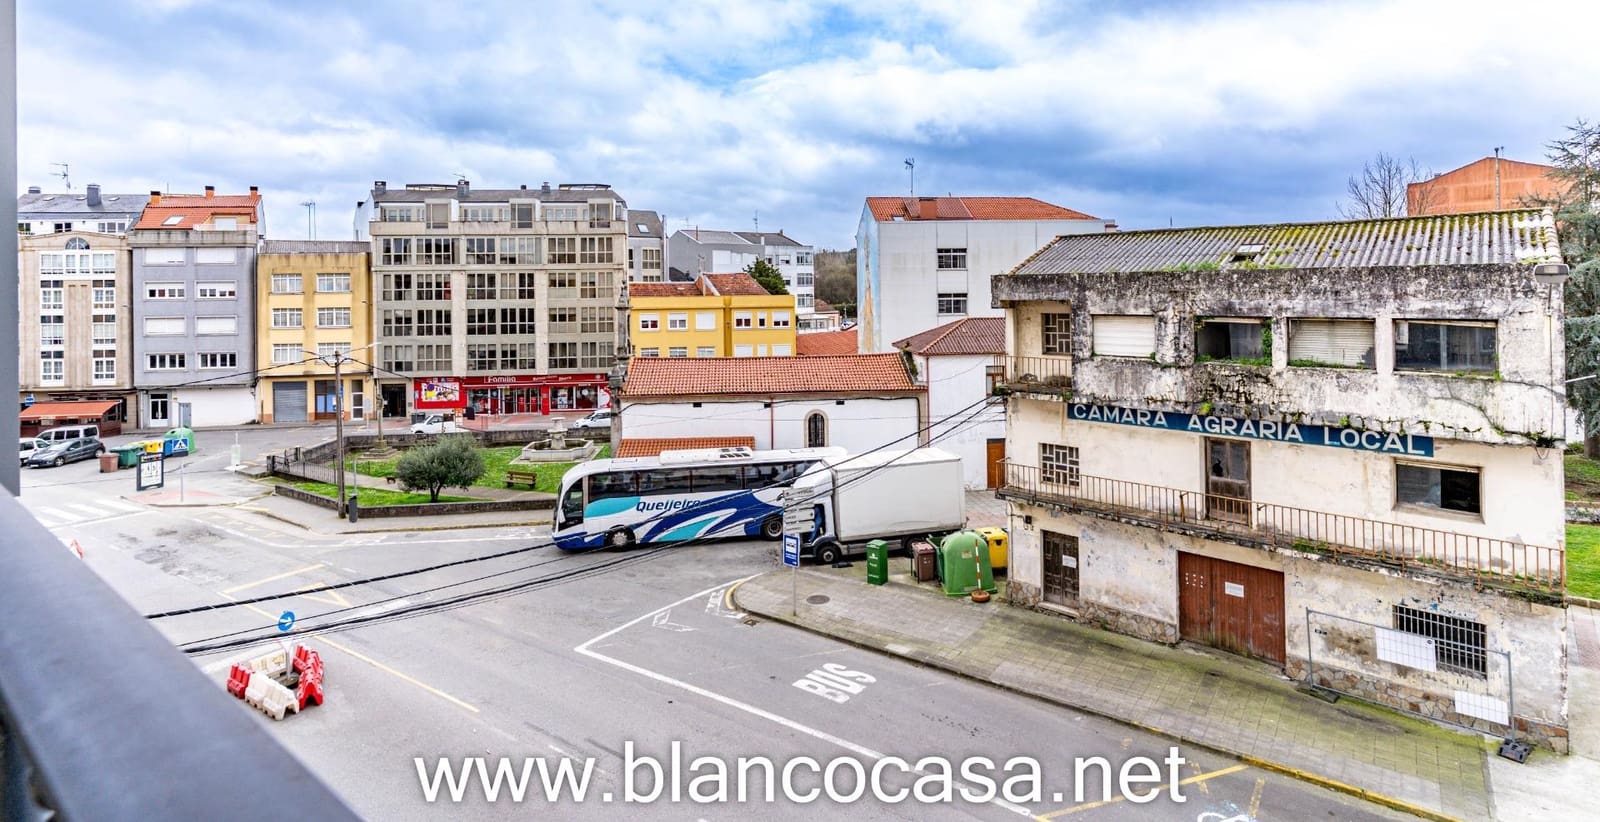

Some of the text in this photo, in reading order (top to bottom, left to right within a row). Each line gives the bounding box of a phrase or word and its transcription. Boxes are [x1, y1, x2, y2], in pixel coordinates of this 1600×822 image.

[1073, 405, 1425, 455] CAMARA AGRARIA LOCAL
[636, 499, 701, 513] Queijeiro
[792, 663, 877, 704] BUS
